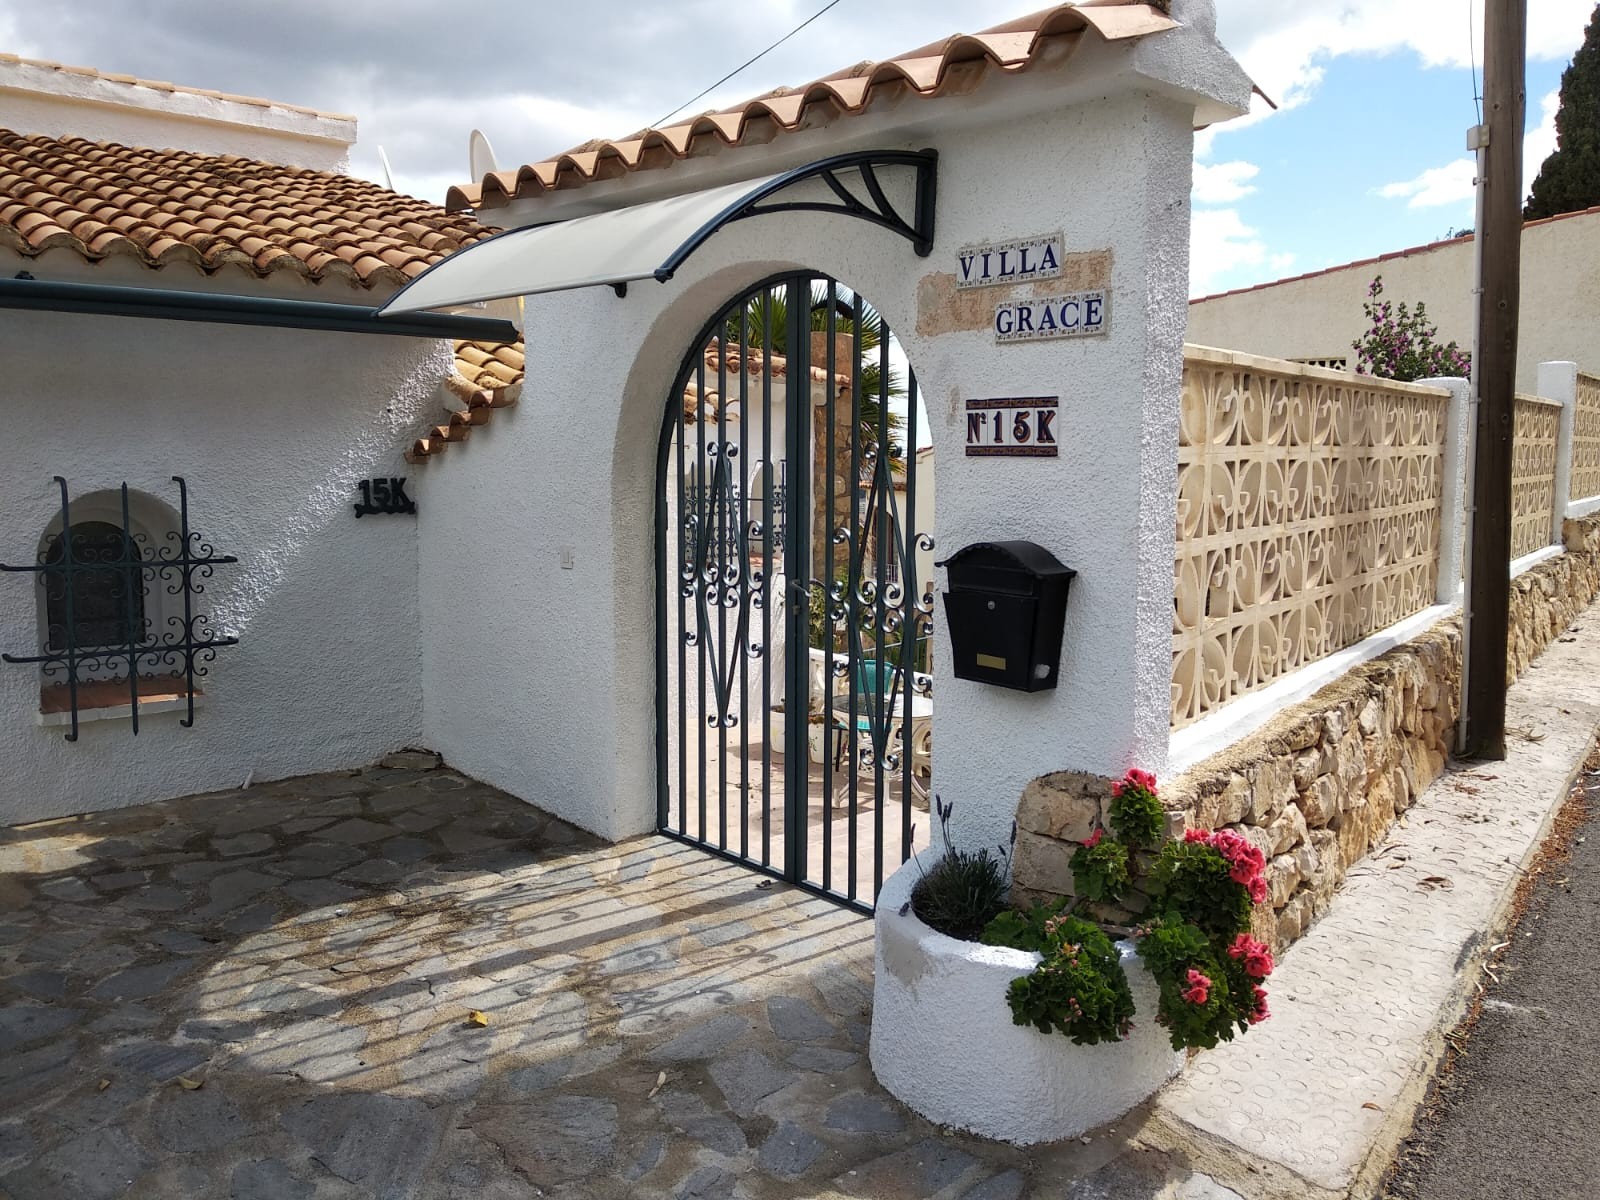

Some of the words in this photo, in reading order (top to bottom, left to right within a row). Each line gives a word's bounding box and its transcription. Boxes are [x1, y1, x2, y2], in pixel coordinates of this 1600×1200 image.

[959, 244, 1059, 281] VILLA
[996, 298, 1103, 334] GRACE
[357, 477, 415, 515] 15K
